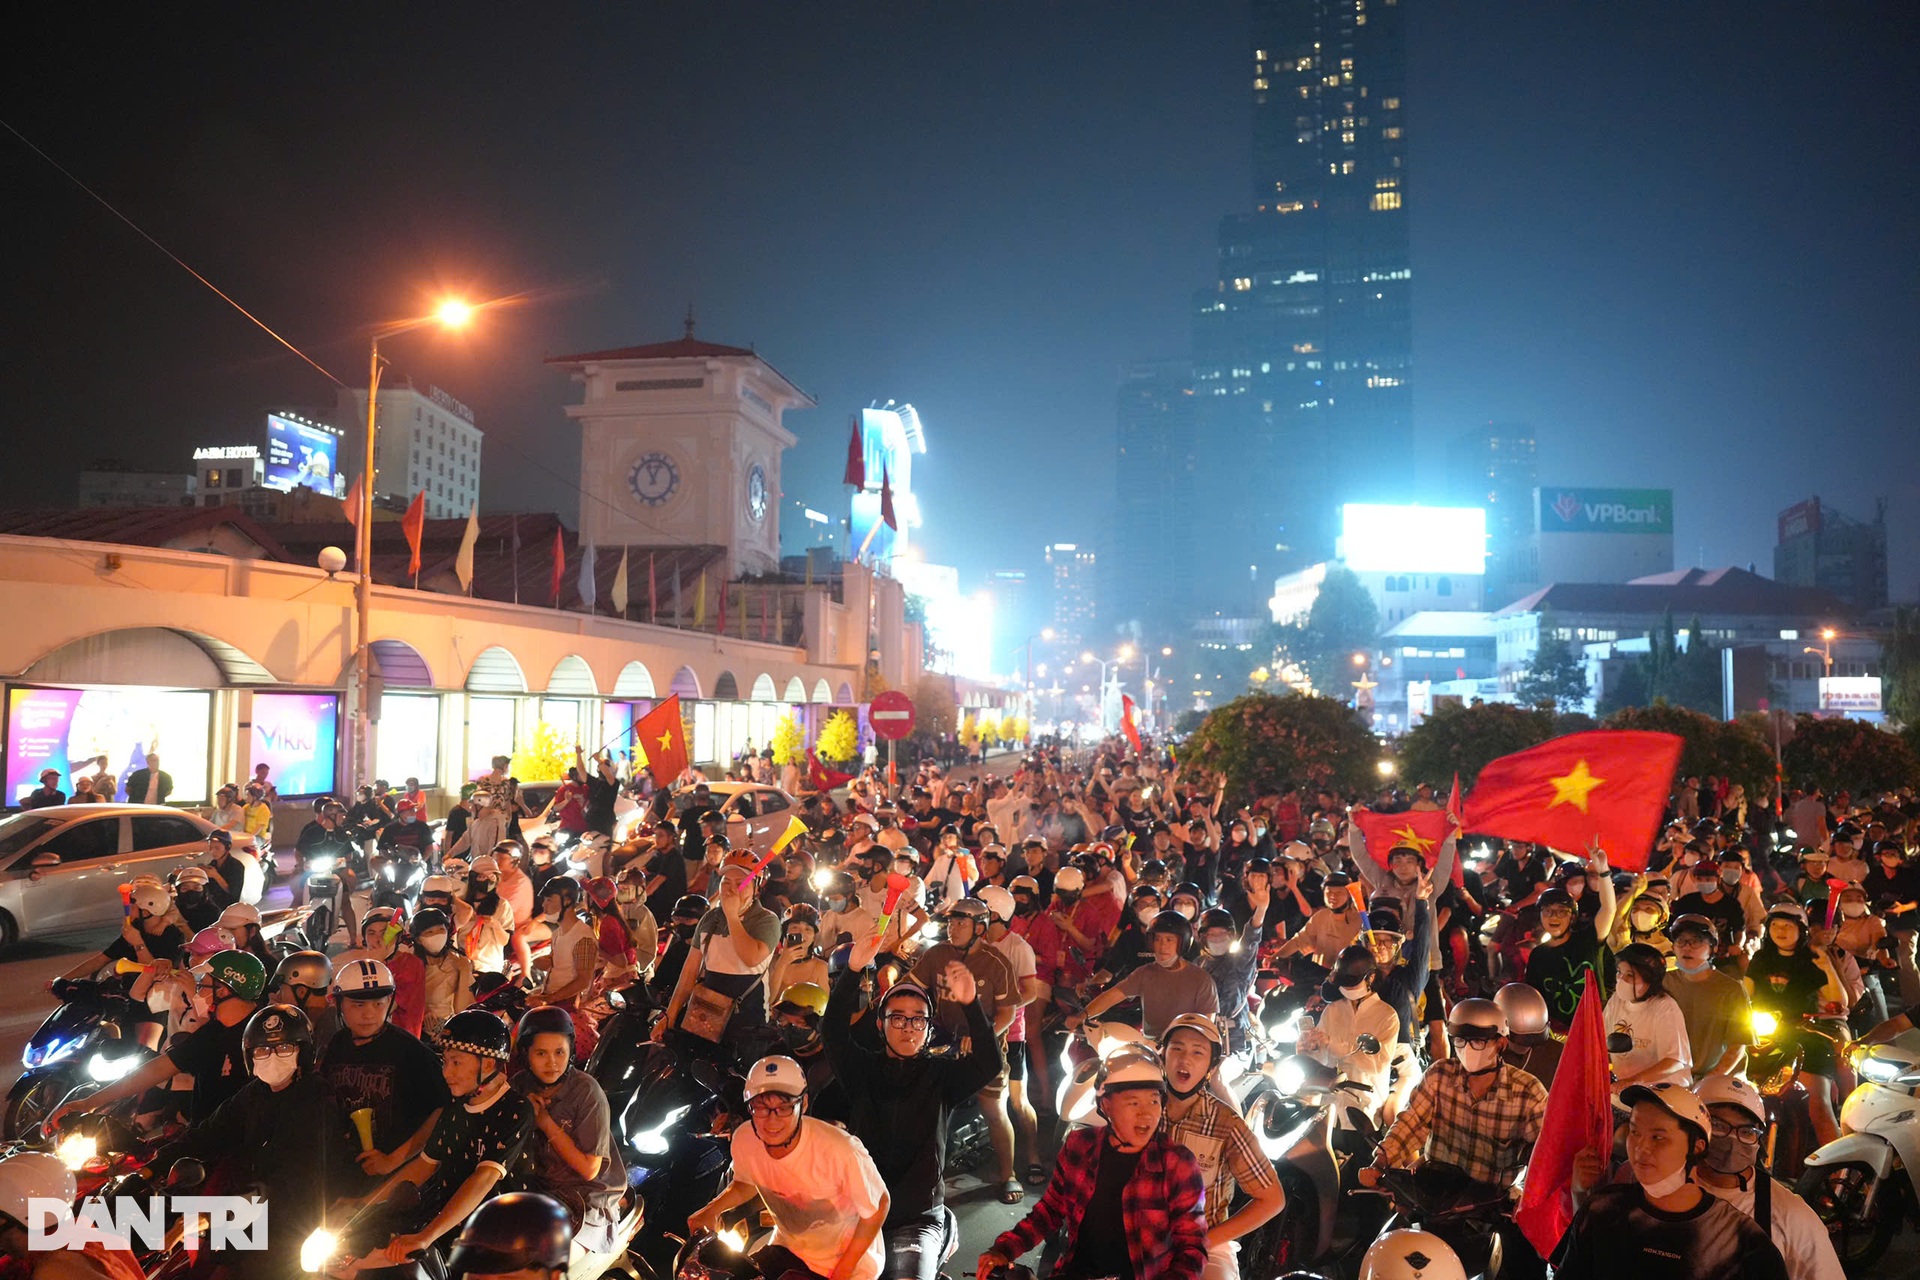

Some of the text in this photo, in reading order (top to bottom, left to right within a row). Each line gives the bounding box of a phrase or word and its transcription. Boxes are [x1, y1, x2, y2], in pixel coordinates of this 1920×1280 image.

[226, 446, 260, 459] HOTEL
[1584, 503, 1662, 523] VPBank
[223, 966, 247, 984] Grab
